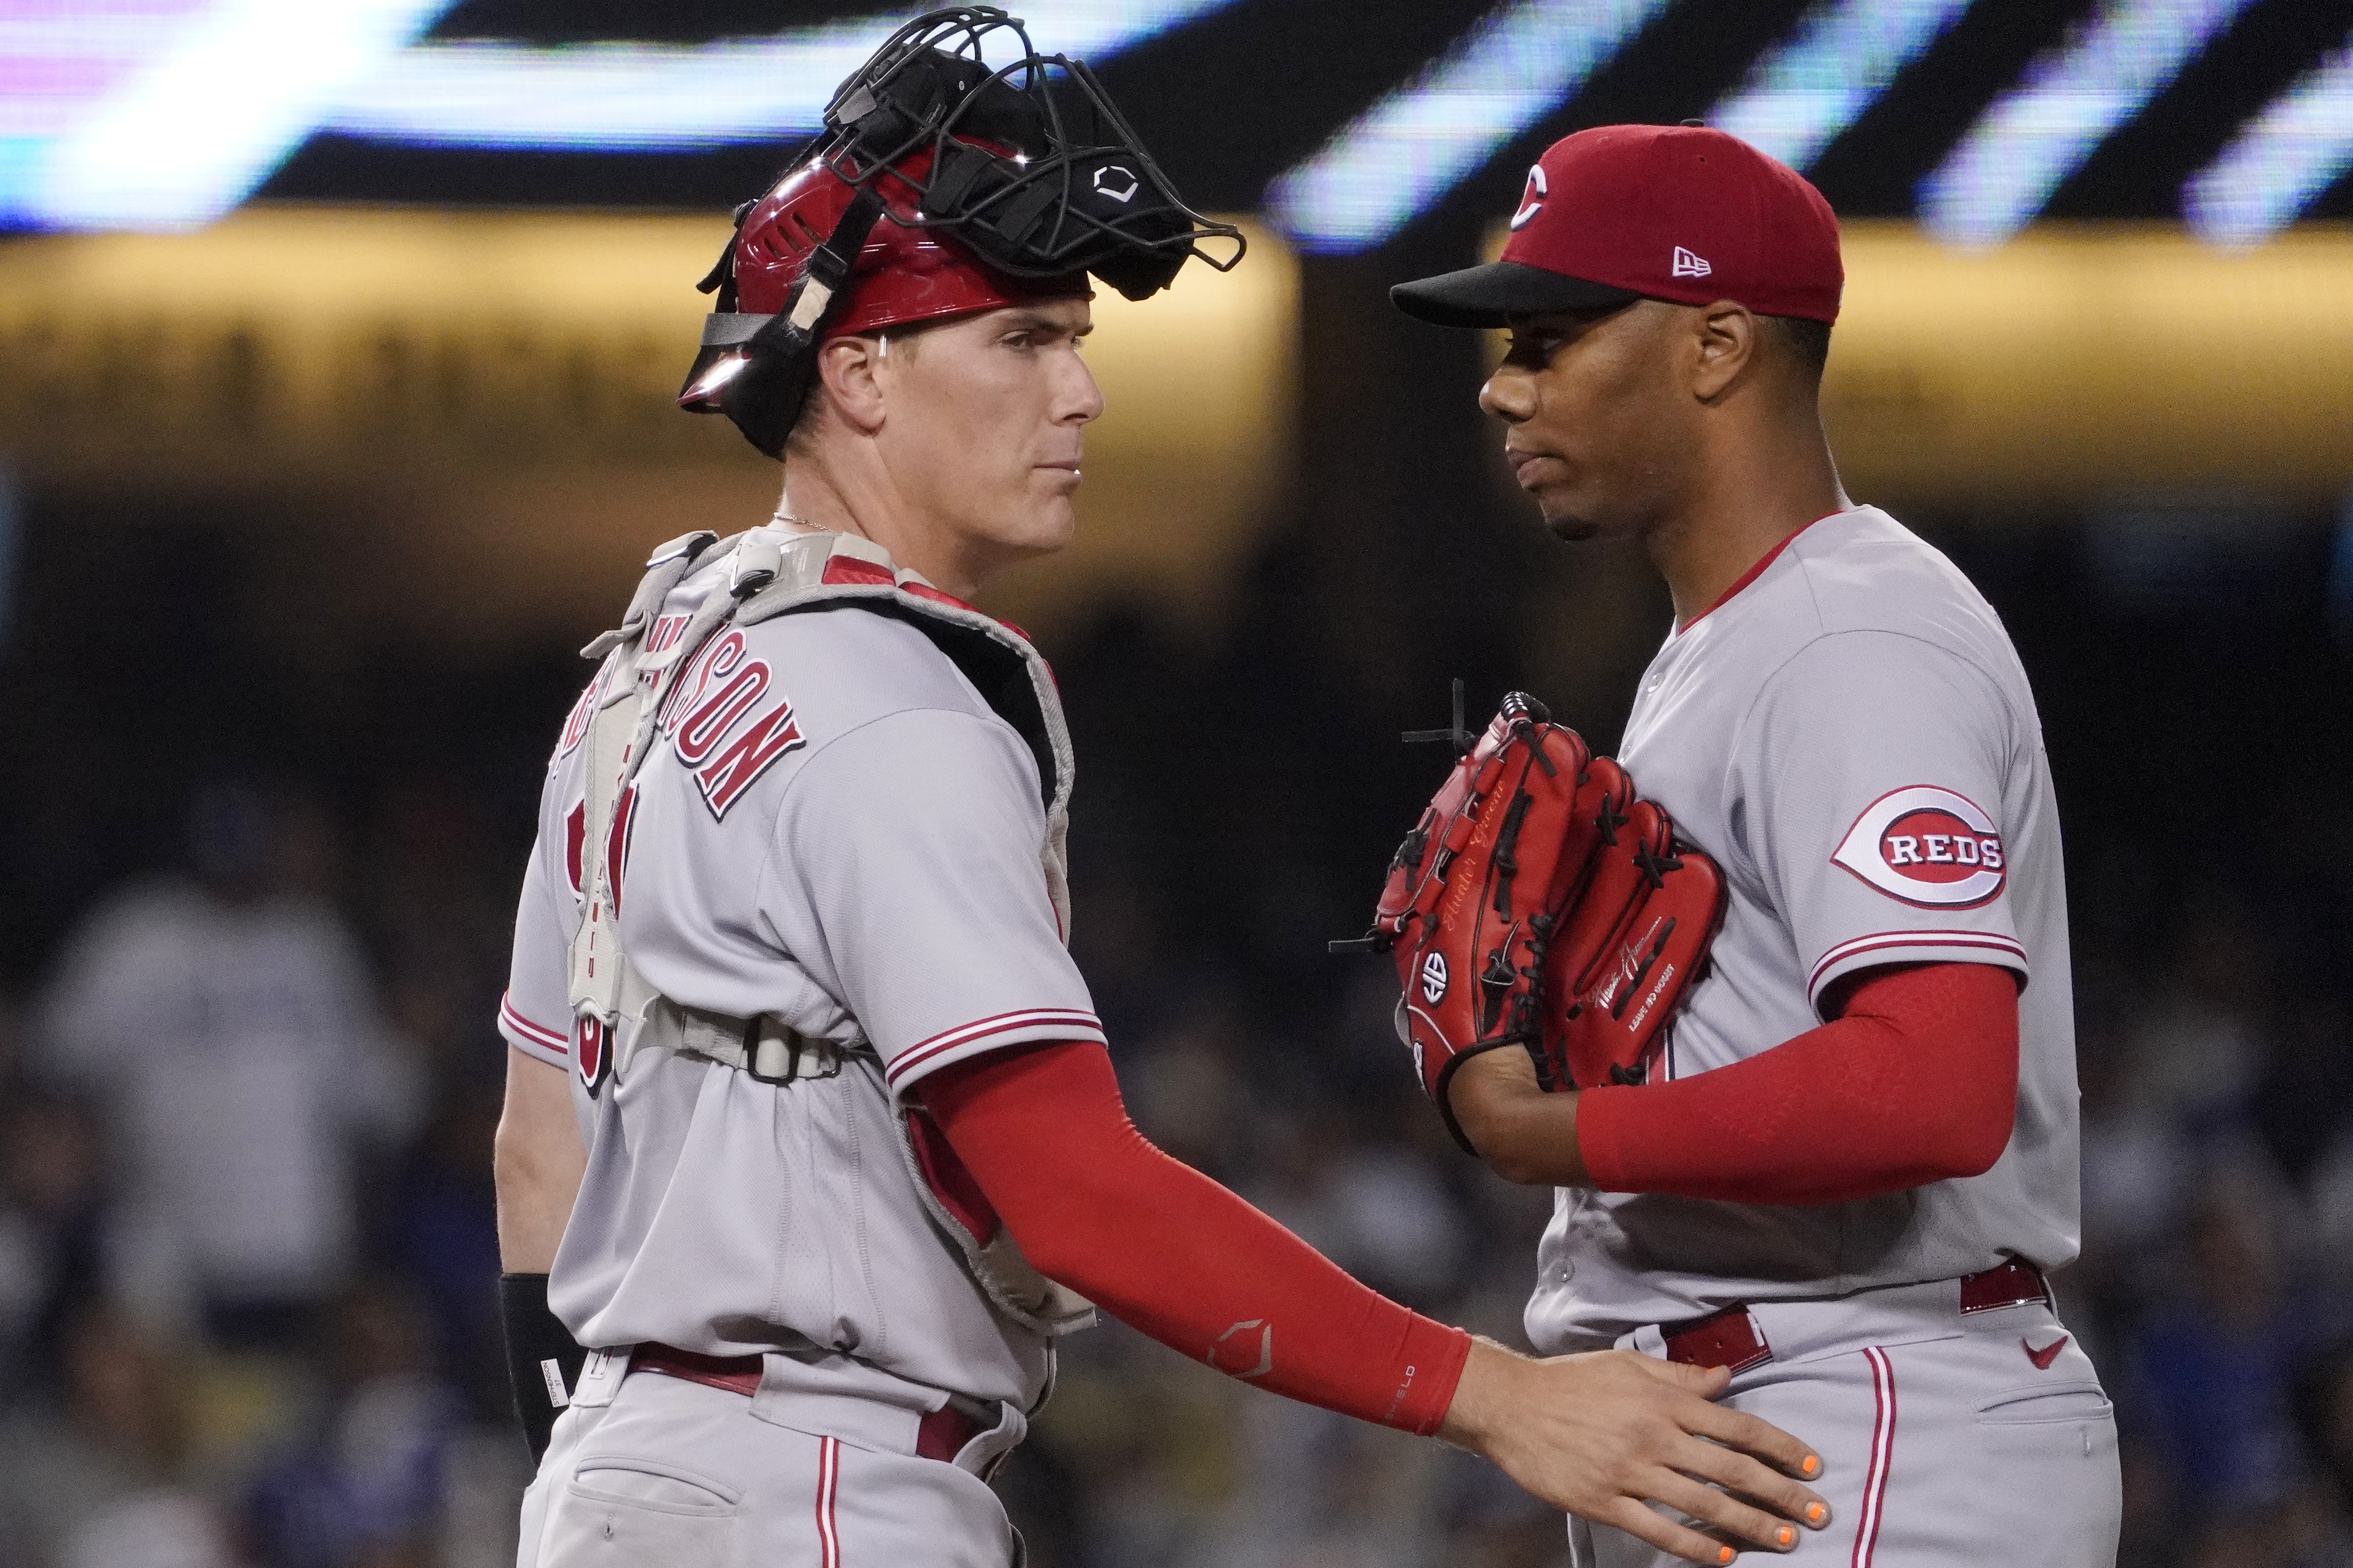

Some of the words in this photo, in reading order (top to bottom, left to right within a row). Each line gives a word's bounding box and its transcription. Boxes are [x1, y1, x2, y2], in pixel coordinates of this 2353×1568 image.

[1887, 834, 2004, 870] REDS
[1628, 1005, 1648, 1032] LEAVE
[1645, 992, 1657, 1008] NO
[543, 1362, 560, 1406] STEPHENSON
[554, 1379, 562, 1387] 37
